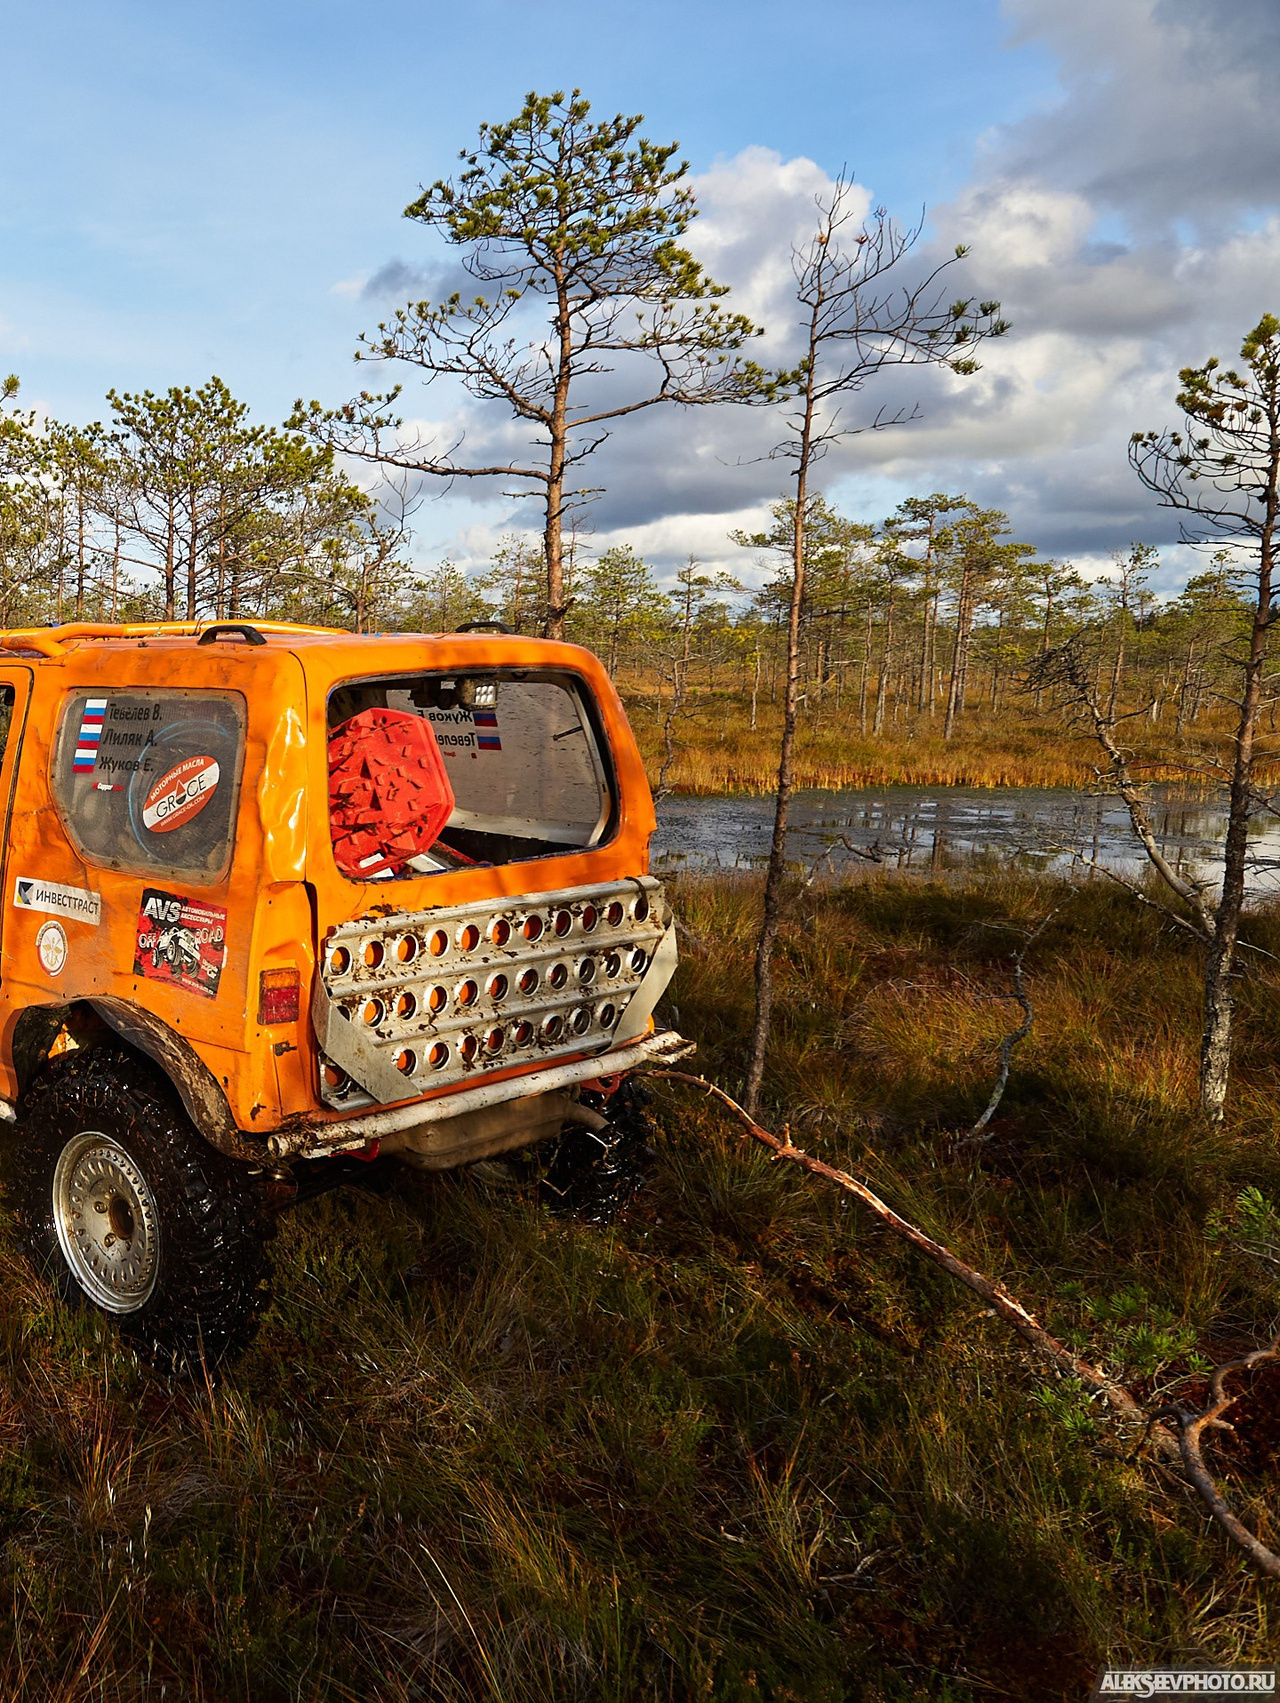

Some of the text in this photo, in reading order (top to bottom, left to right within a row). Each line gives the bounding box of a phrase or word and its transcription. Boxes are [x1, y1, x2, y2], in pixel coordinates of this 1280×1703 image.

[99, 756, 140, 774] Жуков
[150, 758, 205, 802] МОТОРНЫЕ МАСЛА
[35, 889, 99, 915] ИНВЕСТТРАСТ
[142, 897, 182, 923] AVS
